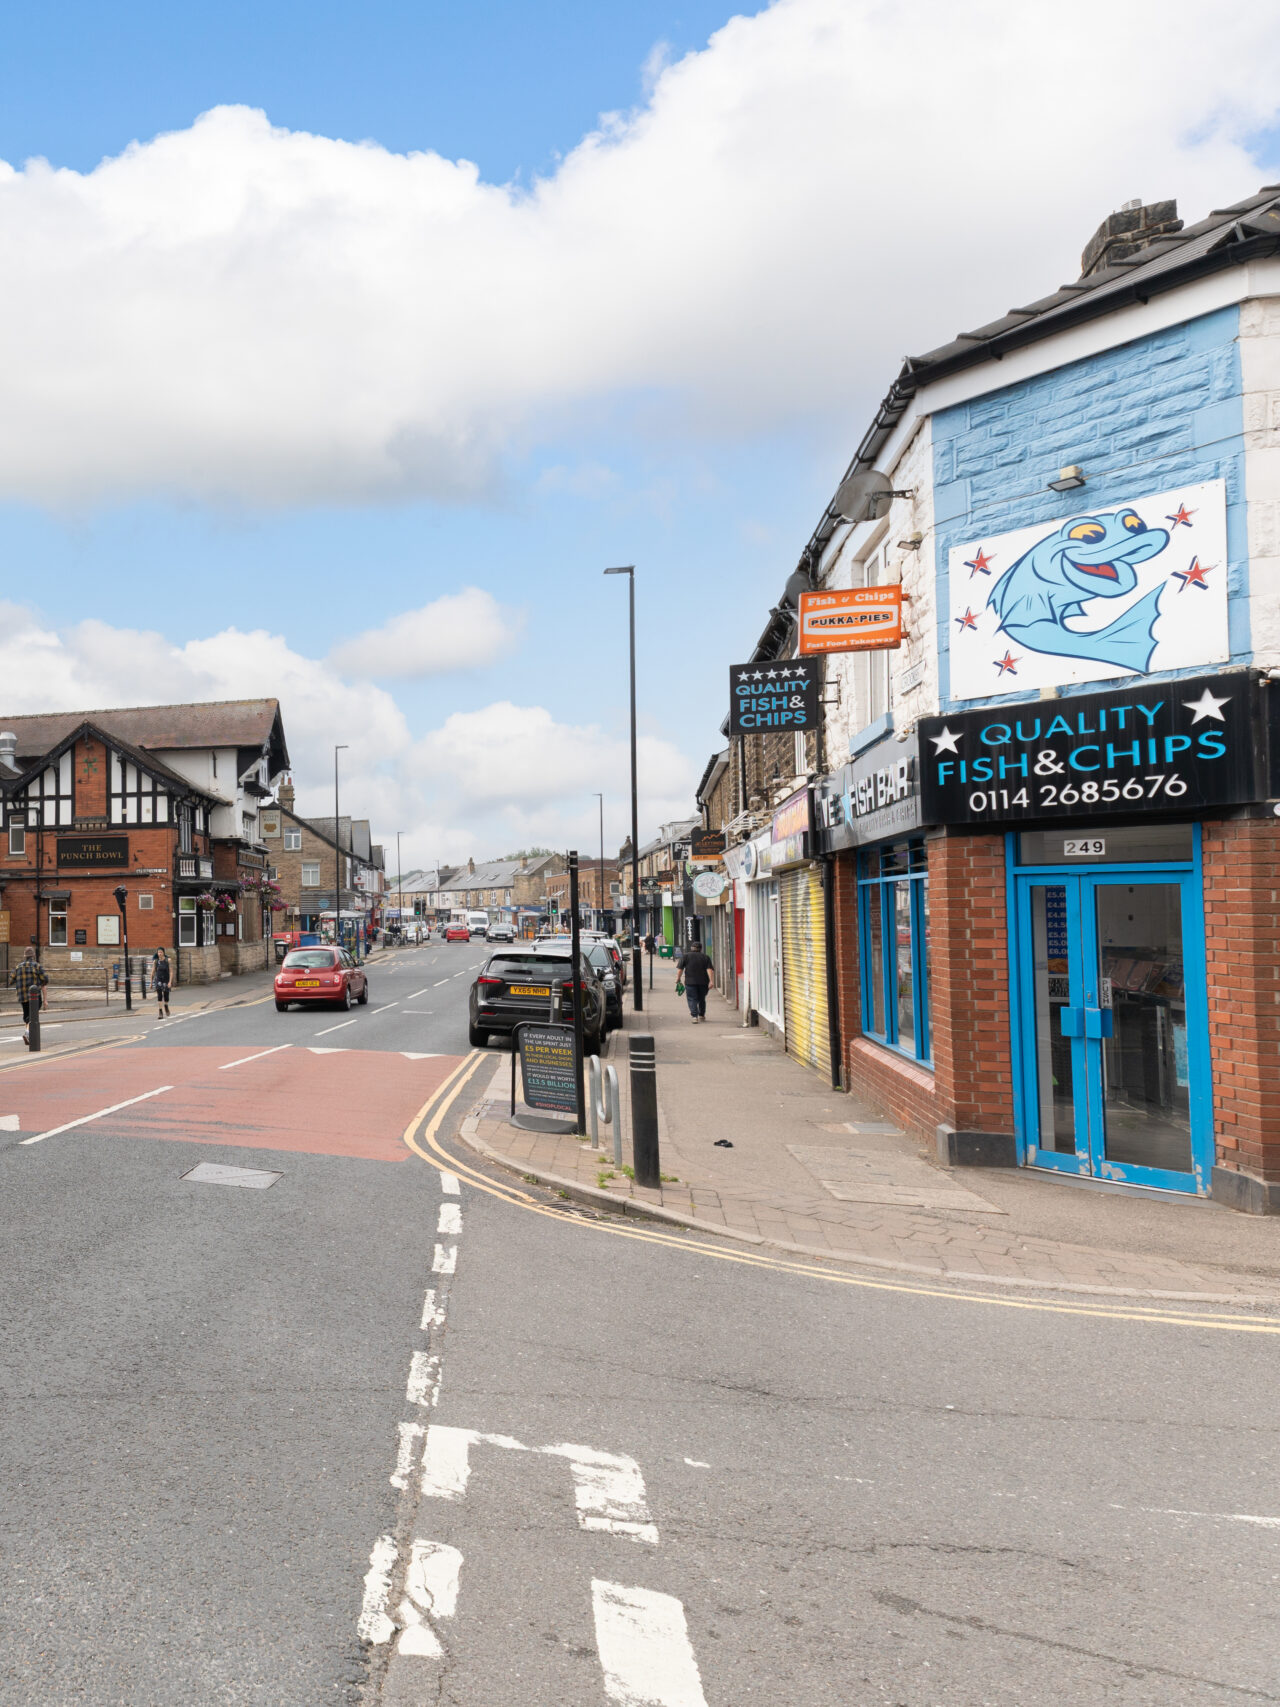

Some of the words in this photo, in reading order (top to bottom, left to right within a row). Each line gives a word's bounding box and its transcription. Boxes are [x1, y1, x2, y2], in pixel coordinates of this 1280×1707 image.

[807, 597, 836, 607] Fish
[854, 592, 895, 602] Chips
[735, 679, 811, 696] QUALITY
[739, 710, 807, 728] CHIPS
[980, 700, 1165, 746] QUALITY
[848, 772, 875, 819] FISH
[877, 756, 909, 808] BAR
[969, 788, 1030, 813] 0114
[1039, 773, 1188, 807] 2685676
[60, 852, 93, 860] PUNCH
[82, 844, 102, 852] THE
[1066, 841, 1104, 855] 249
[1102, 980, 1110, 1004] PUSH
[551, 1048, 572, 1056] WEEK
[547, 1080, 575, 1089] BILLION
